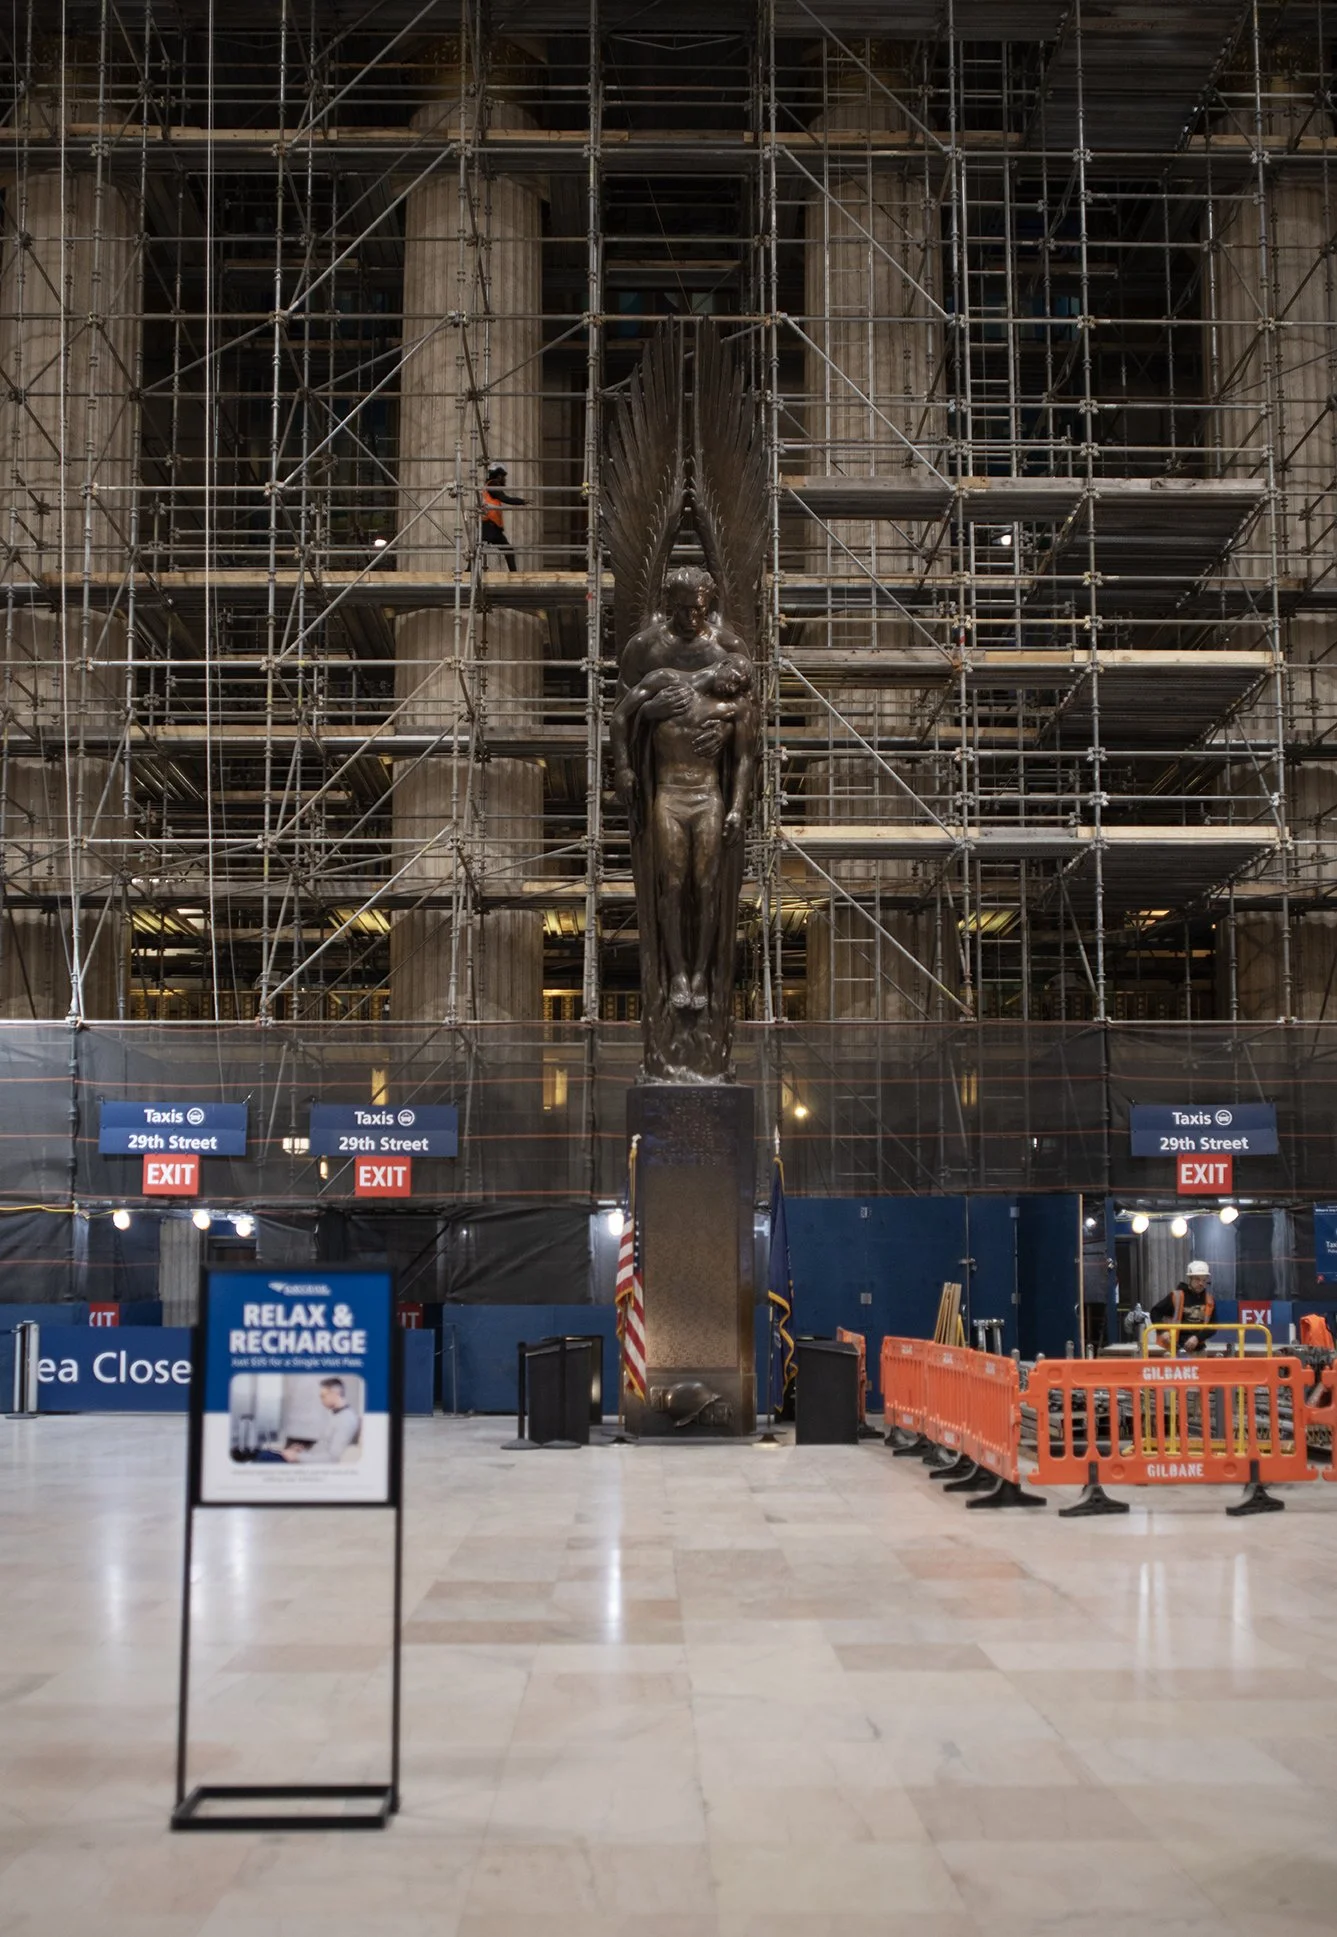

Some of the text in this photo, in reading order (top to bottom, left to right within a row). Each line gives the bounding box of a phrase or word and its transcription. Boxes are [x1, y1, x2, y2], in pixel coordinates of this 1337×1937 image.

[144, 1109, 184, 1123] Taxis
[354, 1111, 394, 1125] Taxis
[1172, 1112, 1211, 1125] Taxis
[128, 1134, 217, 1149] 29th Street
[339, 1136, 429, 1151] 29th Street
[1160, 1137, 1249, 1150] 29th Street
[147, 1163, 195, 1185] EXIT
[359, 1166, 406, 1187] EXIT
[1181, 1163, 1228, 1184] EXIT
[243, 1303, 354, 1328] RELAX &
[229, 1329, 368, 1354] RECHARGE
[93, 1350, 192, 1384] Close
